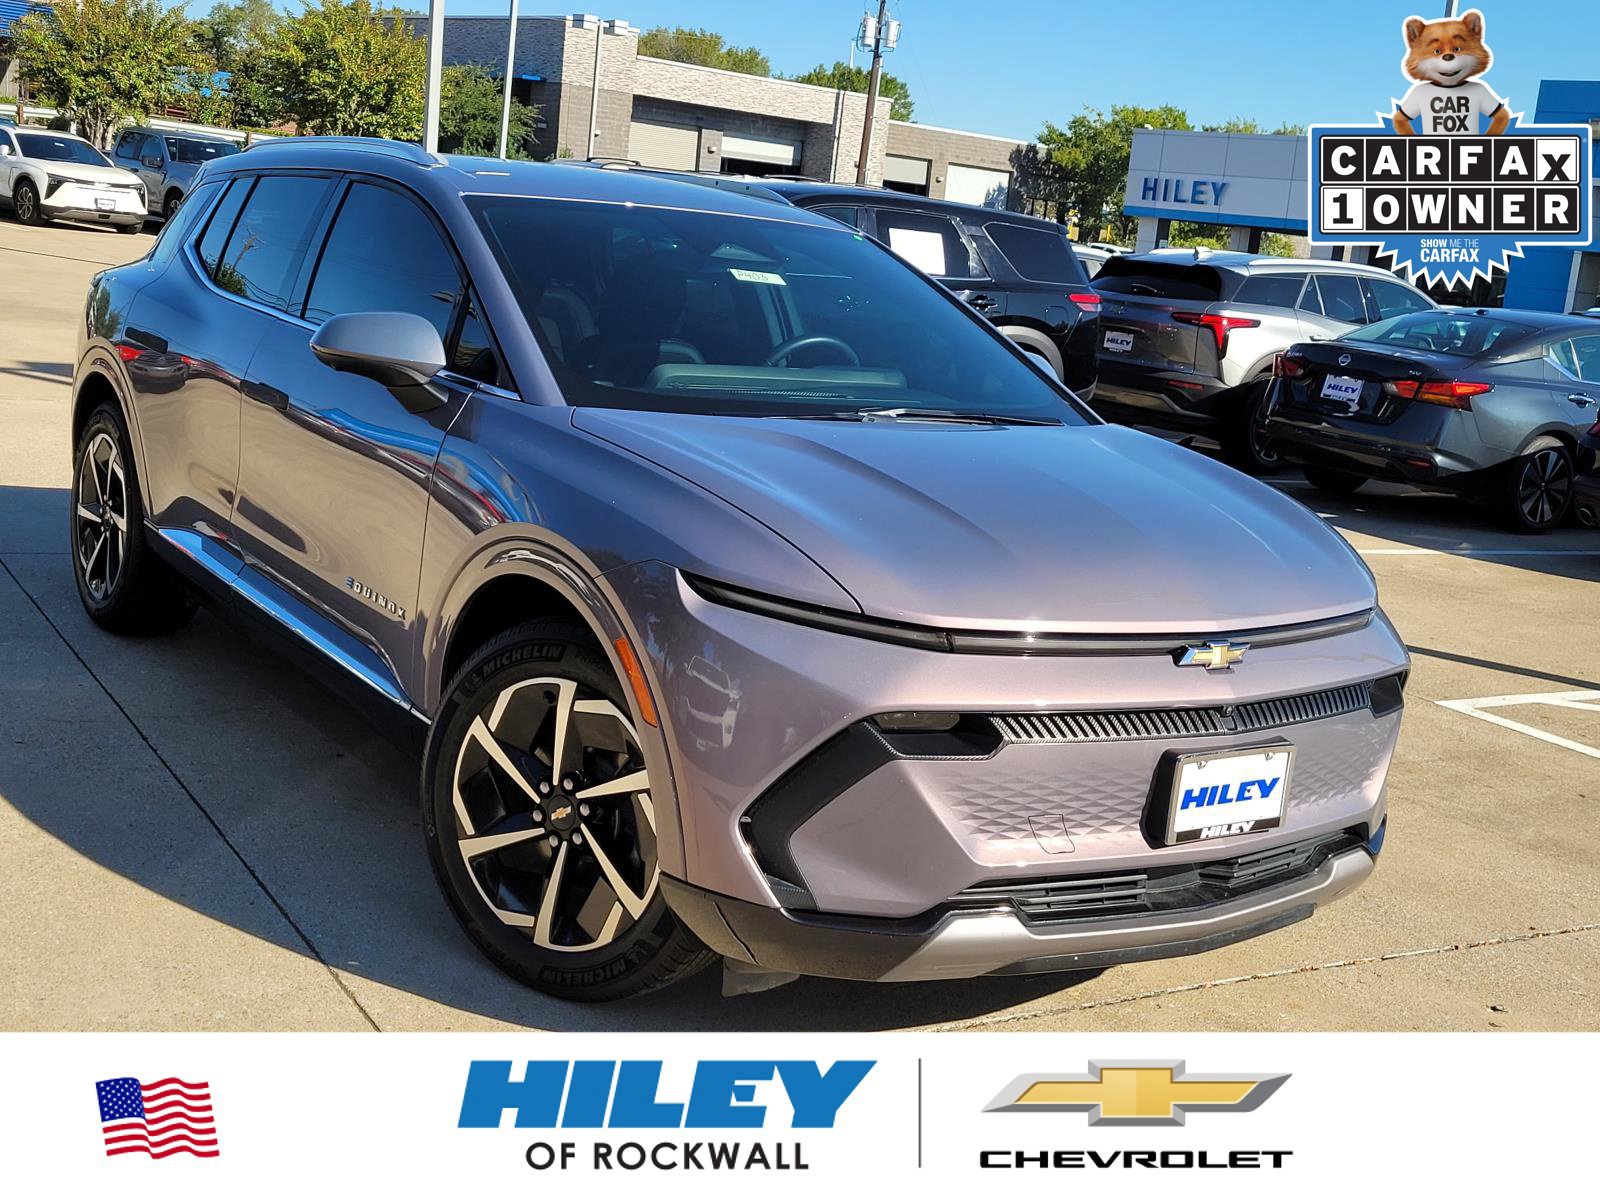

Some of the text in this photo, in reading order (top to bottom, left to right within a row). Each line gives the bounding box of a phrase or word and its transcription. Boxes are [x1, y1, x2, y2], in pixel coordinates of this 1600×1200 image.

[1141, 177, 1230, 206] HILEY
[1106, 337, 1132, 345] HILEY
[1327, 383, 1359, 394] HILEY
[346, 576, 406, 620] EQUINOX
[481, 644, 563, 676] MICHELIN
[1180, 777, 1281, 810] HILEY
[1200, 821, 1256, 839] HILEY
